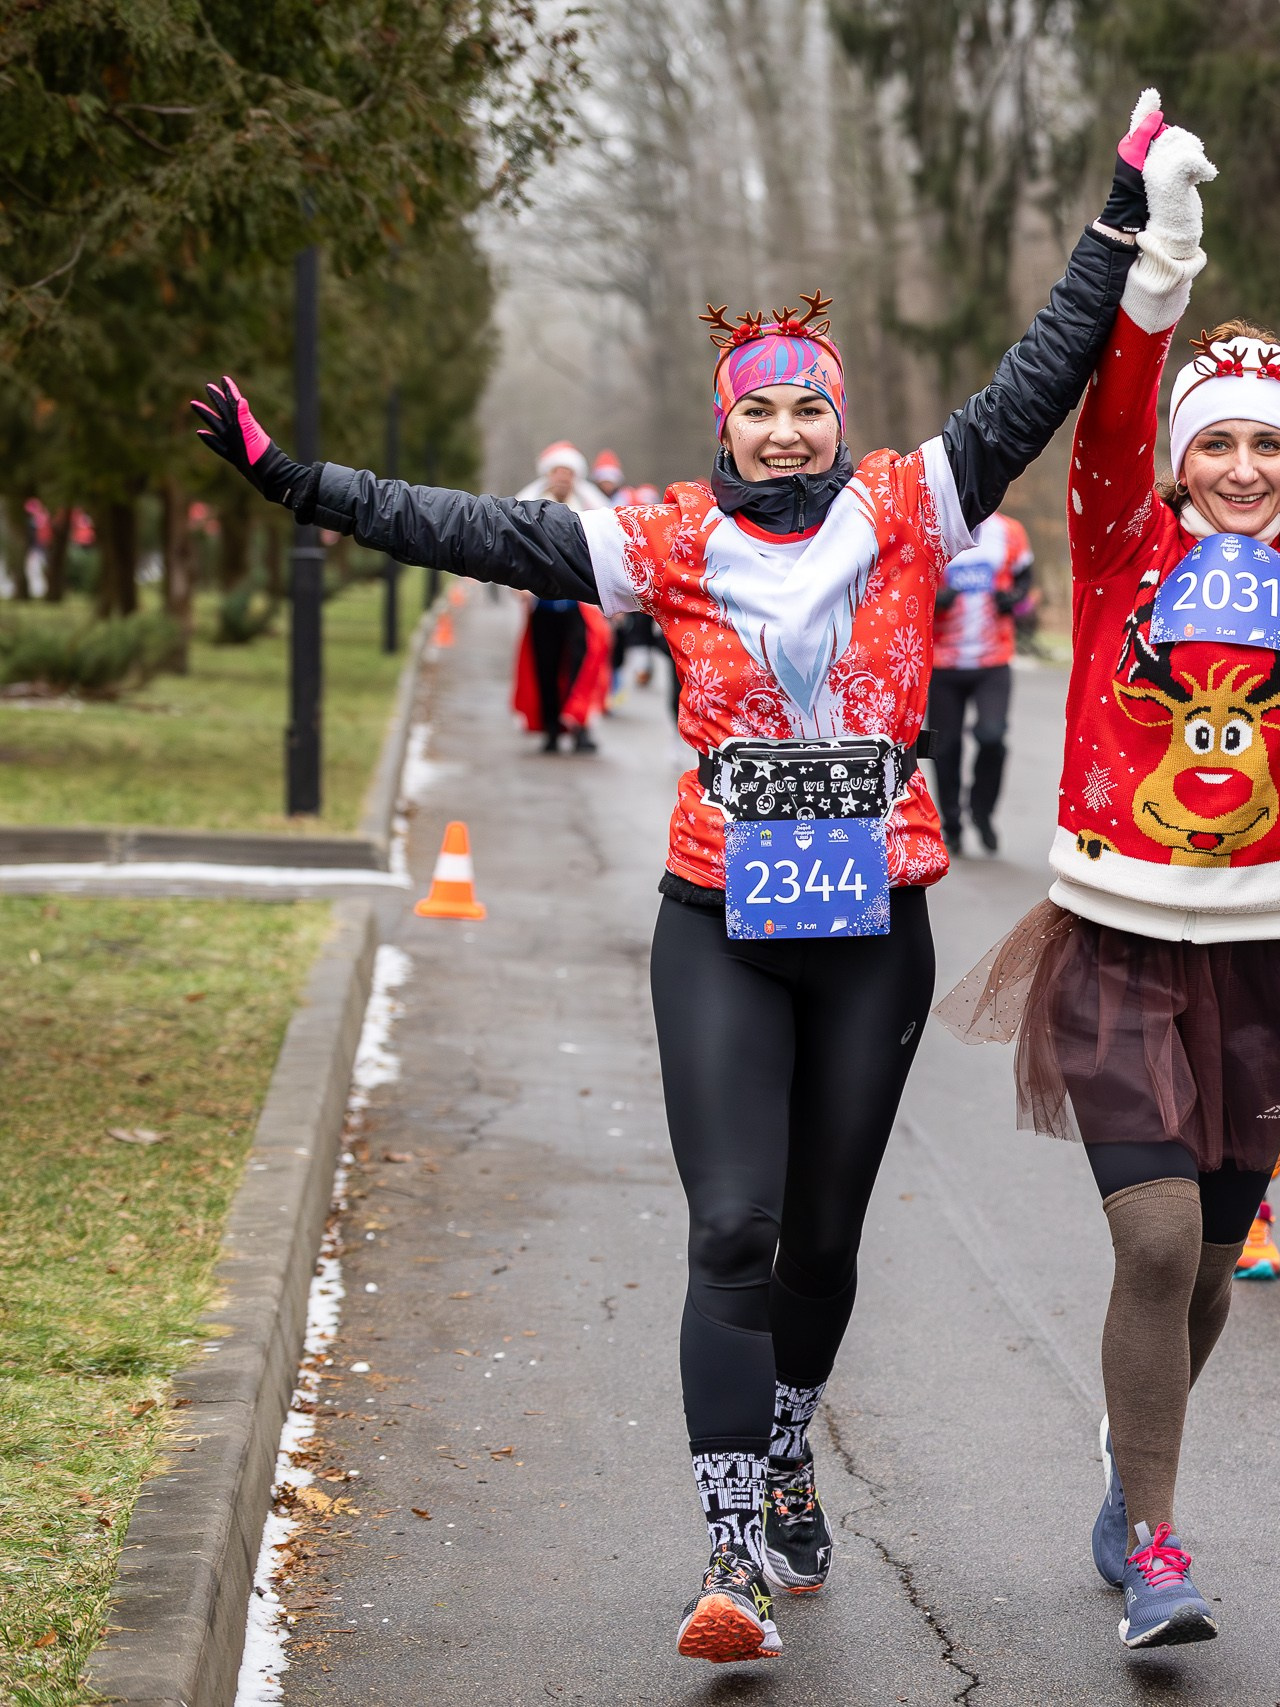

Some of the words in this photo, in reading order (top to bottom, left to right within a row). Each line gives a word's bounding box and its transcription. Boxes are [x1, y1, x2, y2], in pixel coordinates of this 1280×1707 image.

[1172, 569, 1279, 617] 2031
[1215, 626, 1222, 635] 5
[740, 781, 759, 794] IN
[765, 780, 797, 794] RUN
[803, 781, 825, 793] WE
[830, 777, 879, 793] TRUST
[744, 857, 868, 904] 2344
[796, 921, 803, 930] 5
